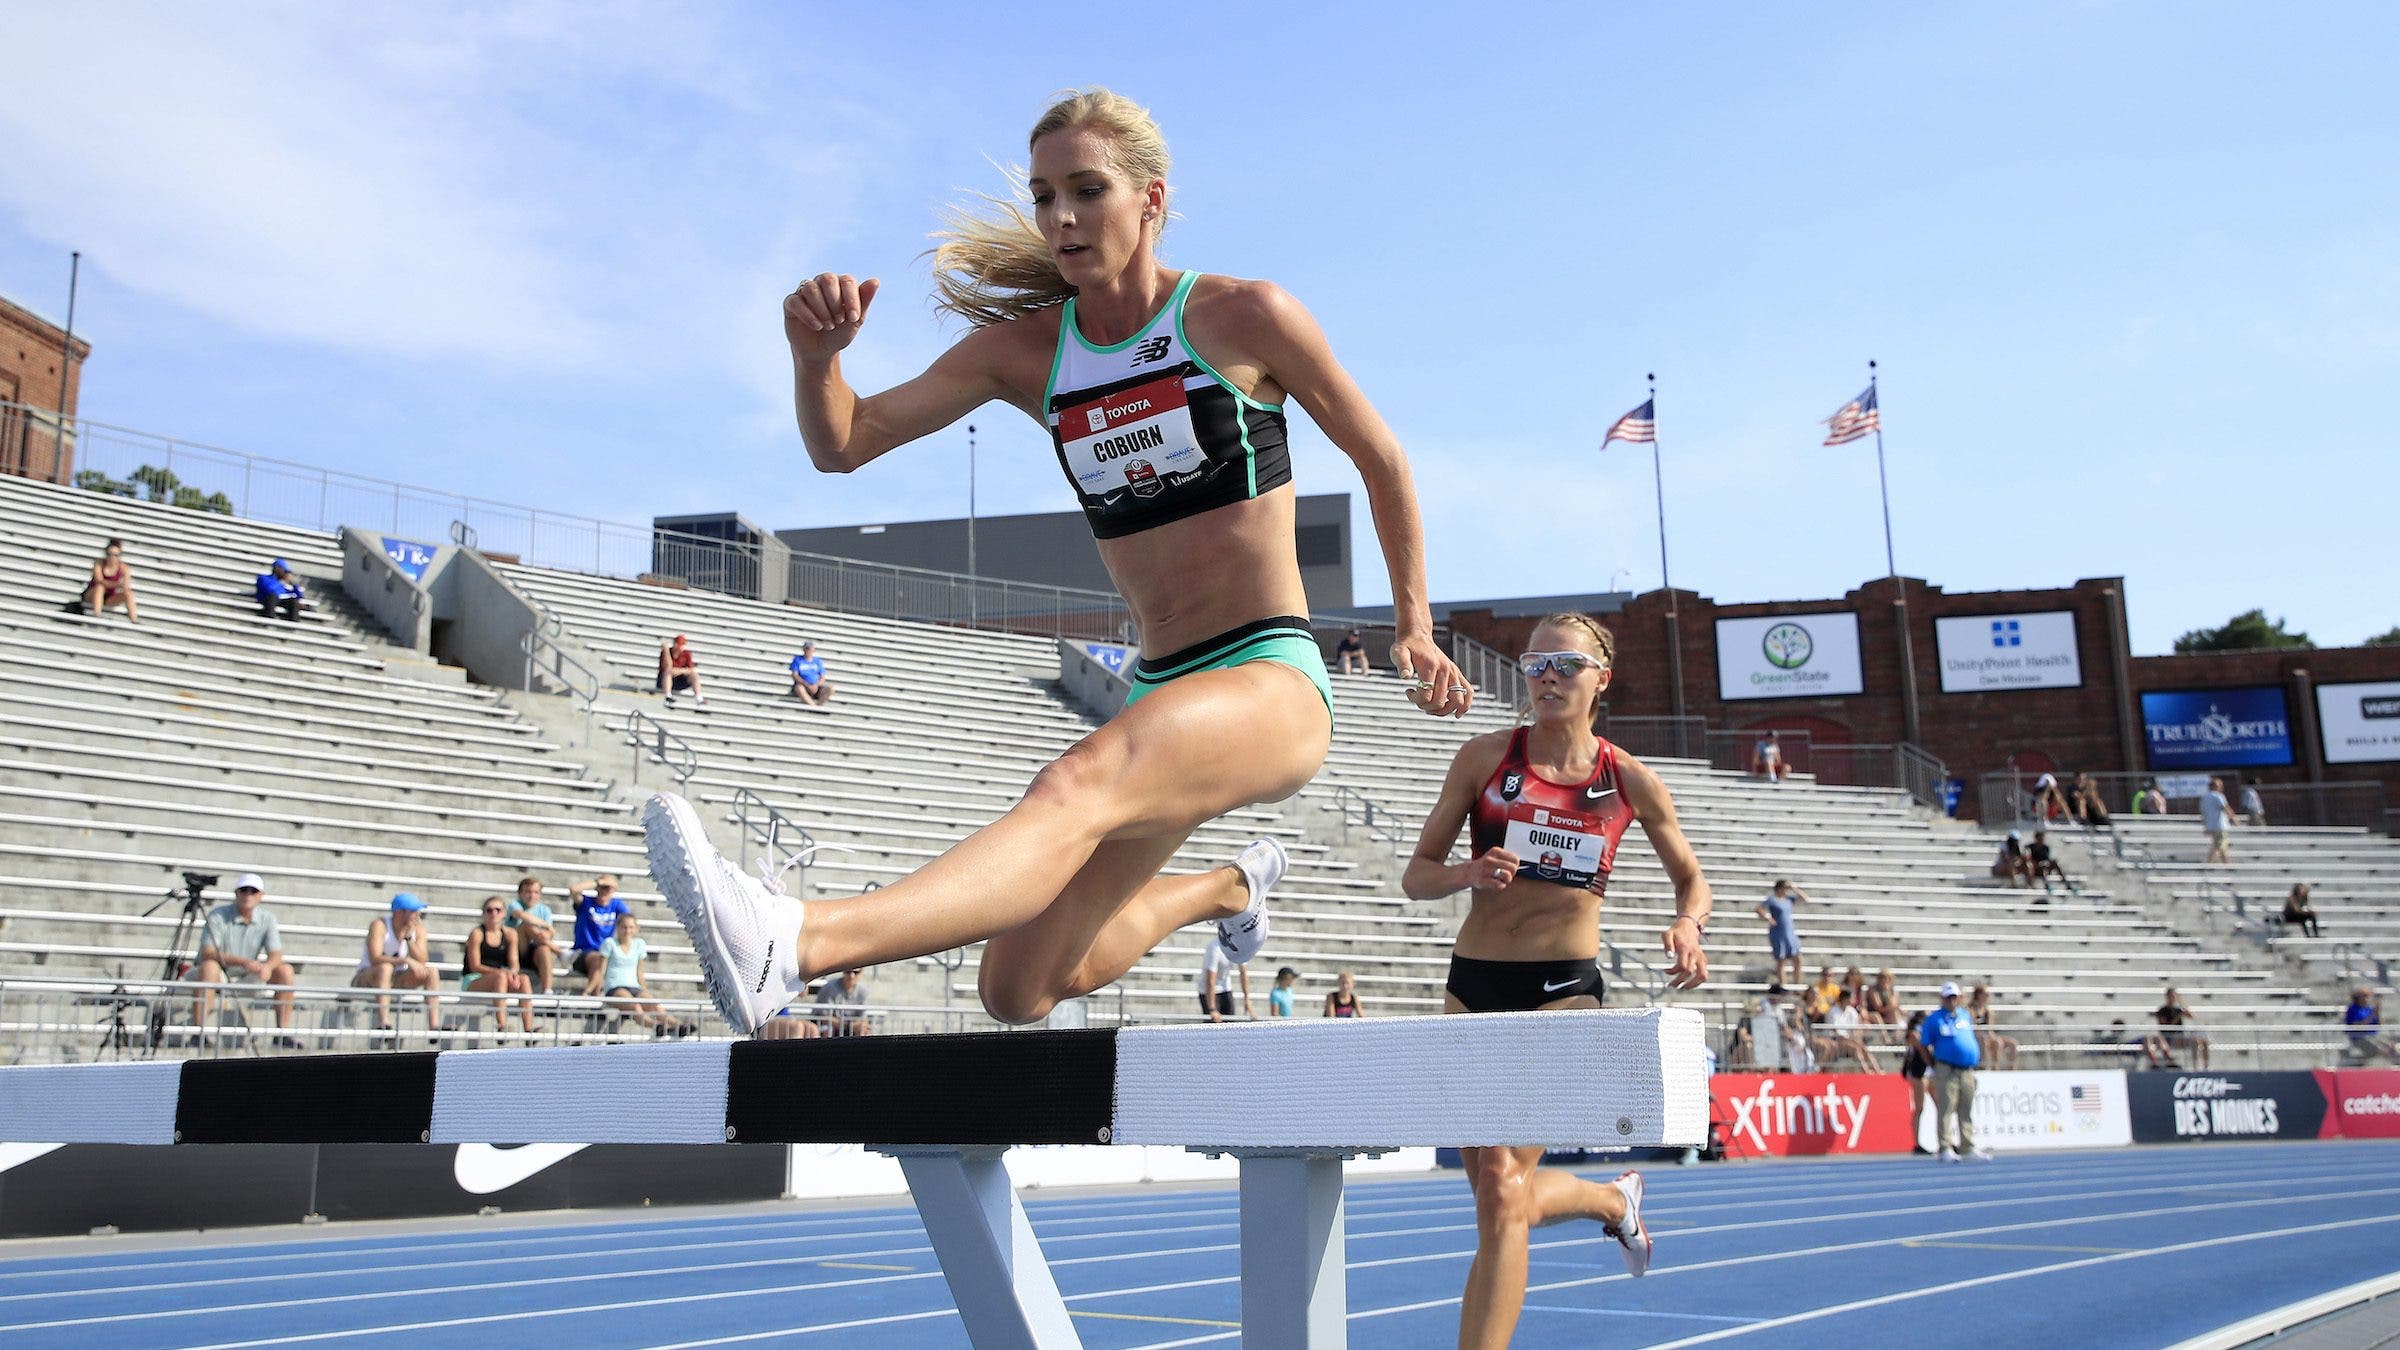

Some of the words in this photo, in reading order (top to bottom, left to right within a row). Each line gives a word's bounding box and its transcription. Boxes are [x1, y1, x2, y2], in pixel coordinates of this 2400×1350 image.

[1106, 398, 1152, 420] TOYOTA
[1093, 424, 1164, 463] COBURN
[1947, 656, 2021, 672] UnityPoint
[2025, 654, 2072, 666] Health
[1750, 671, 1830, 684] GreenState
[1551, 815, 1583, 828] TOYOTA
[1529, 830, 1581, 851] QUIGLEY
[2173, 1077, 2242, 1098] CATCH
[1976, 1085, 2063, 1123] mpians
[1729, 1079, 1871, 1151] xfinity
[2174, 1100, 2210, 1135] DES
[2211, 1099, 2279, 1135] MOINES
